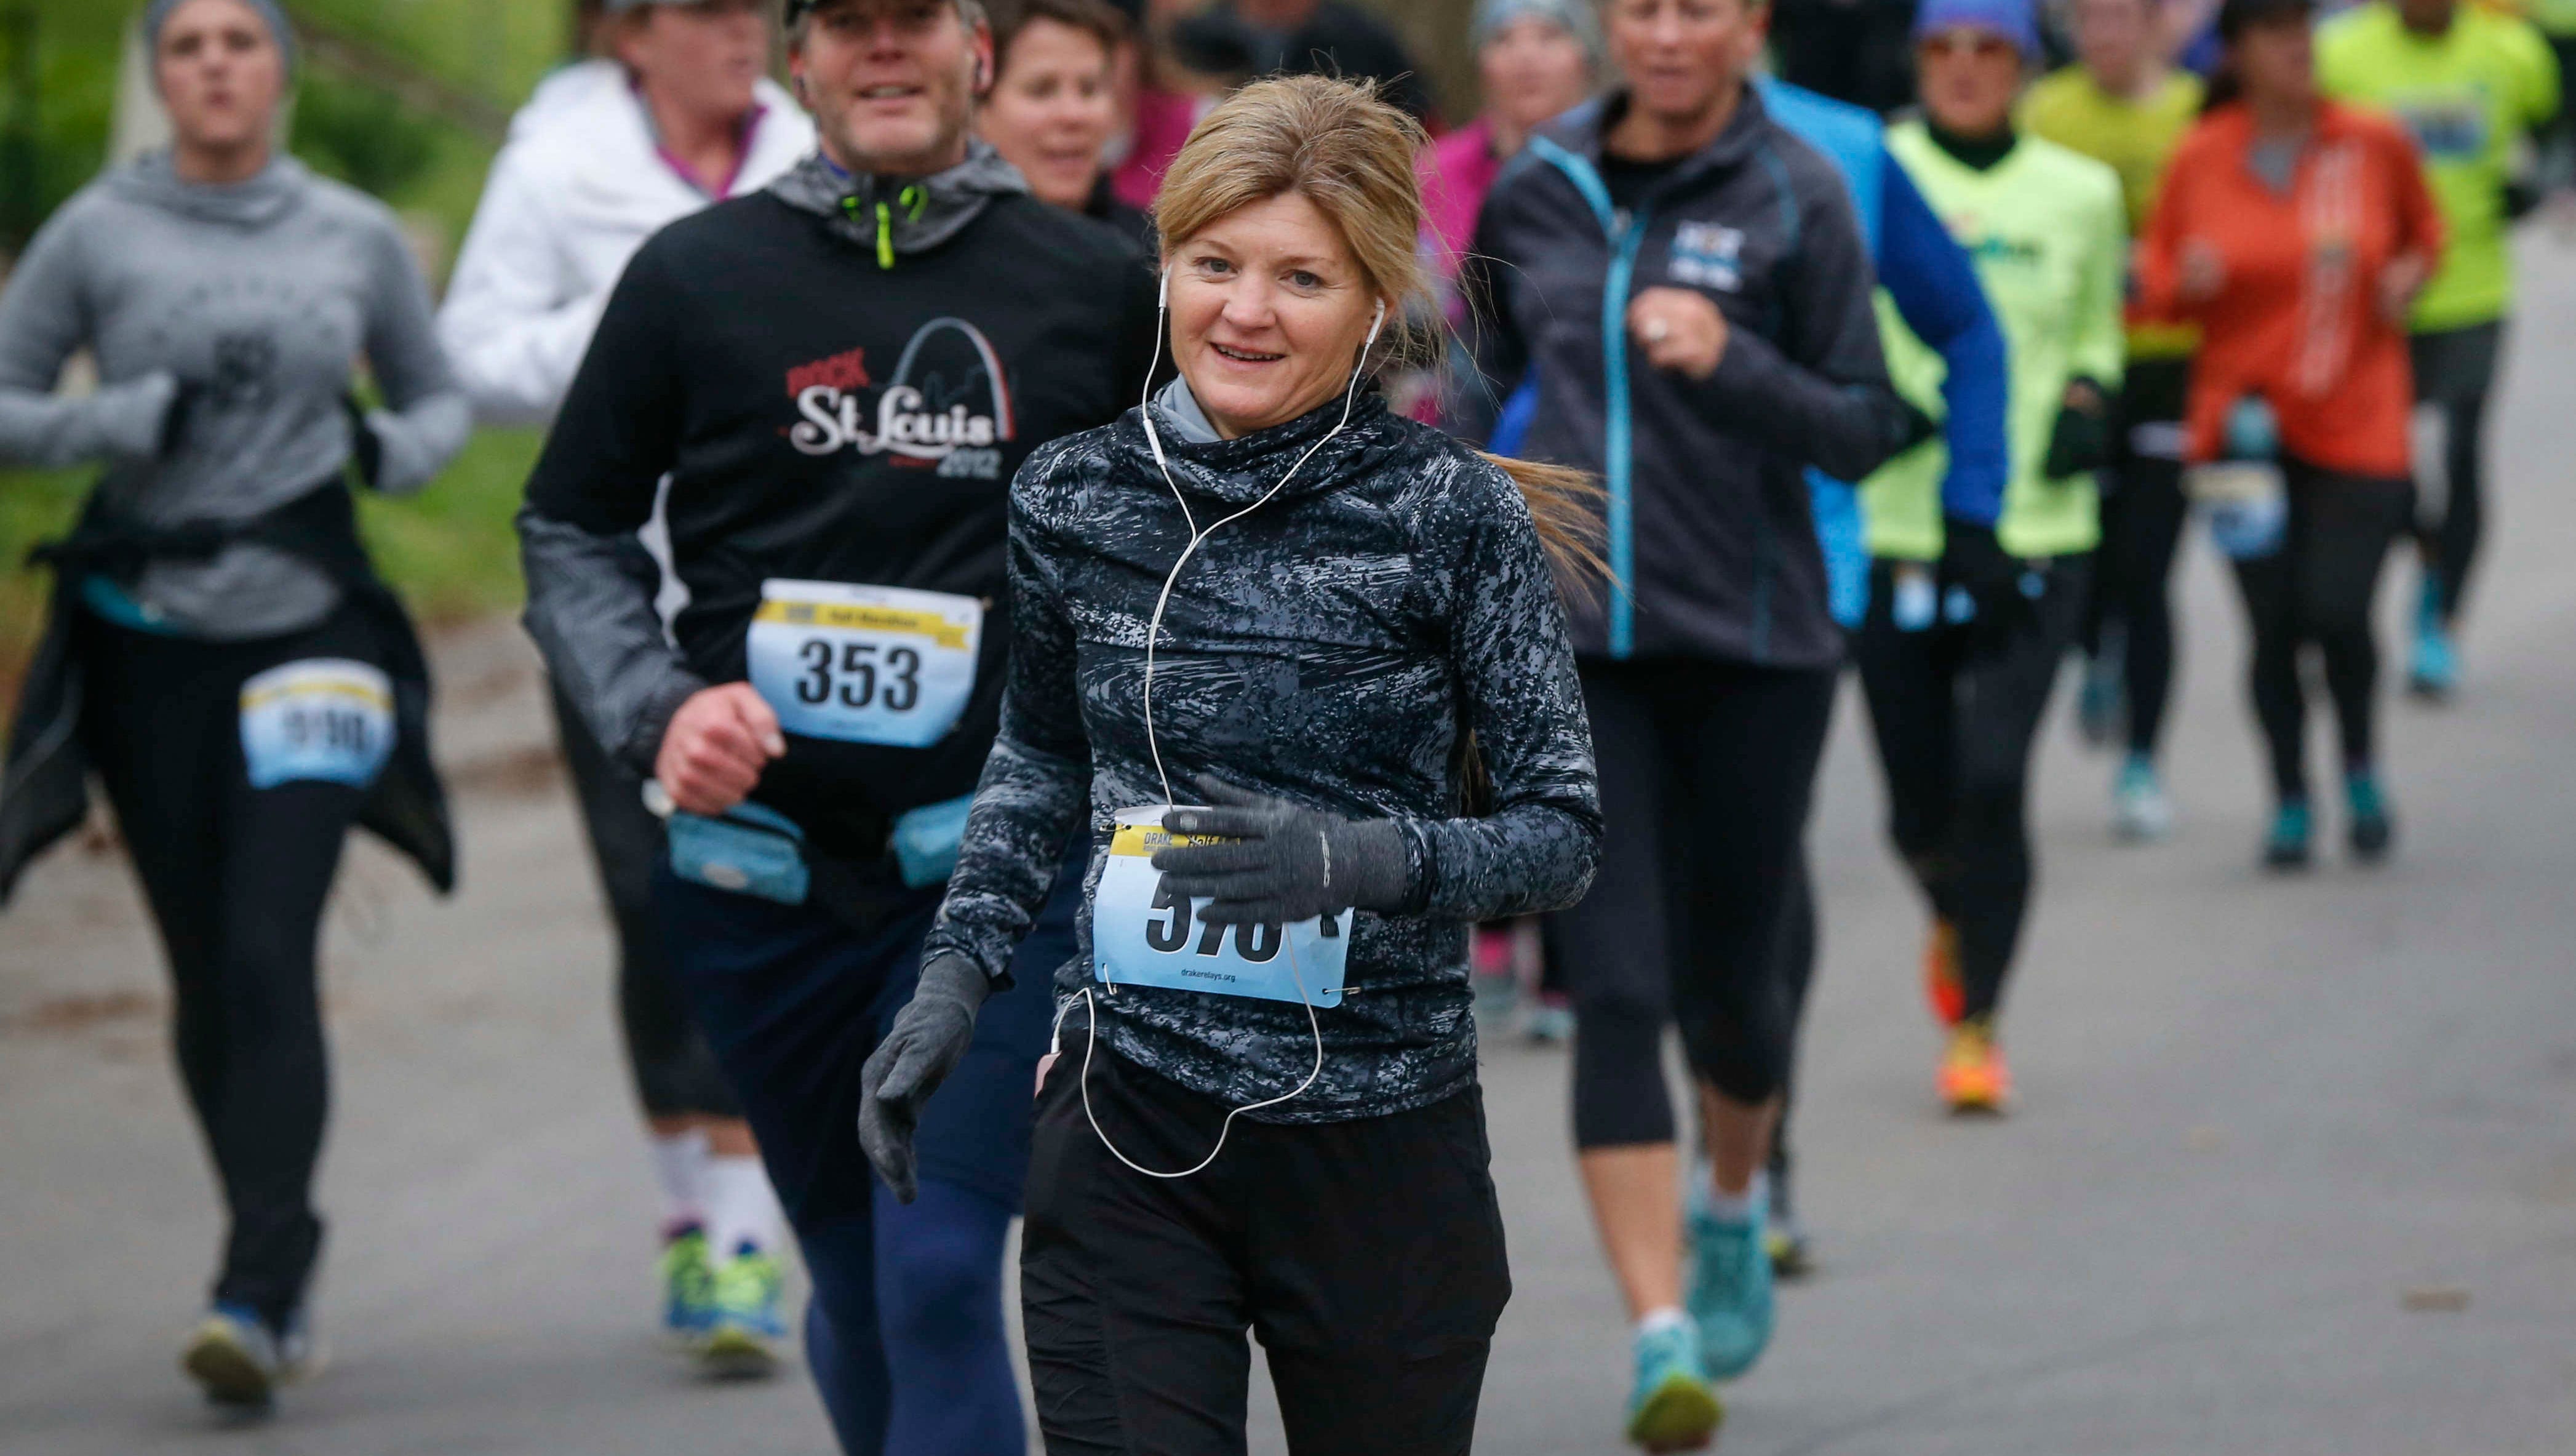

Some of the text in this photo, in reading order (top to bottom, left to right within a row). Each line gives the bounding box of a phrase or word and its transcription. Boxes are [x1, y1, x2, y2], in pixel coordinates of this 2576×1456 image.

[856, 386, 995, 459] Louis
[796, 639, 920, 712] 353
[1181, 969, 1235, 983] drakerelays.org
